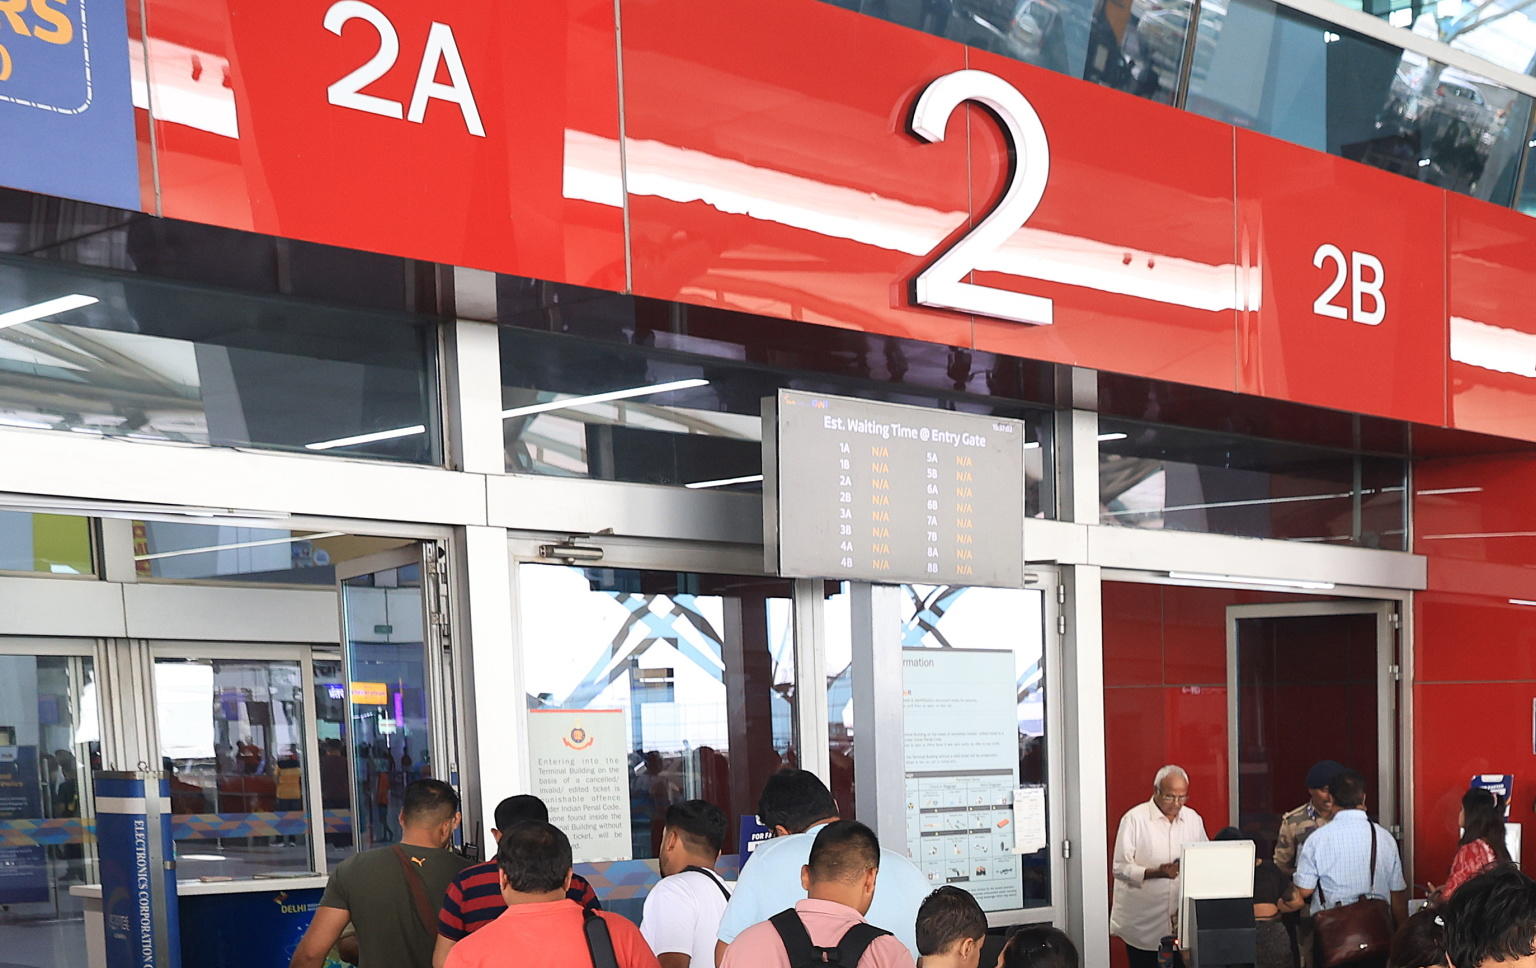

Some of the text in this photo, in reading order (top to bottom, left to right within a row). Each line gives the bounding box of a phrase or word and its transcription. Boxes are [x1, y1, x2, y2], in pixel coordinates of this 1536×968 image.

[323, 0, 487, 138] 2A
[910, 68, 1054, 327] 2
[1312, 243, 1387, 327] 2B
[824, 415, 987, 448] Est. Waiting Time @ Entry Gate
[840, 443, 888, 457] 1A N/A
[927, 452, 973, 466] 5A N/A
[840, 460, 888, 473] 1B N/A
[927, 468, 973, 481] 5B N/A
[840, 476, 889, 489] 2A N/A
[927, 484, 973, 497] 6A N/A
[840, 492, 889, 505] 2B N/A
[927, 500, 973, 513] 6B N/A
[840, 508, 889, 521] 3A N/A
[927, 516, 973, 528] 7A N/A
[840, 525, 889, 538] 3B N/A
[927, 531, 973, 544] 7B N/A
[840, 541, 889, 554] 4A N/A
[927, 547, 973, 560] 8A N/A
[840, 558, 889, 570] 4B N/A
[927, 563, 973, 575] 8B N/A
[903, 657, 934, 668] rmation
[537, 758, 575, 766] Entering
[539, 767, 566, 775] Terminal
[570, 767, 595, 775] Building
[539, 777, 557, 785] basis
[593, 785, 611, 793] ticket
[583, 804, 601, 812] Penal
[548, 815, 565, 823] yone
[571, 823, 597, 831] Building
[751, 833, 764, 841] FOR
[133, 819, 150, 889] ELECTRONICS
[281, 904, 307, 914] DELHI
[138, 890, 153, 964] CORPORATION
